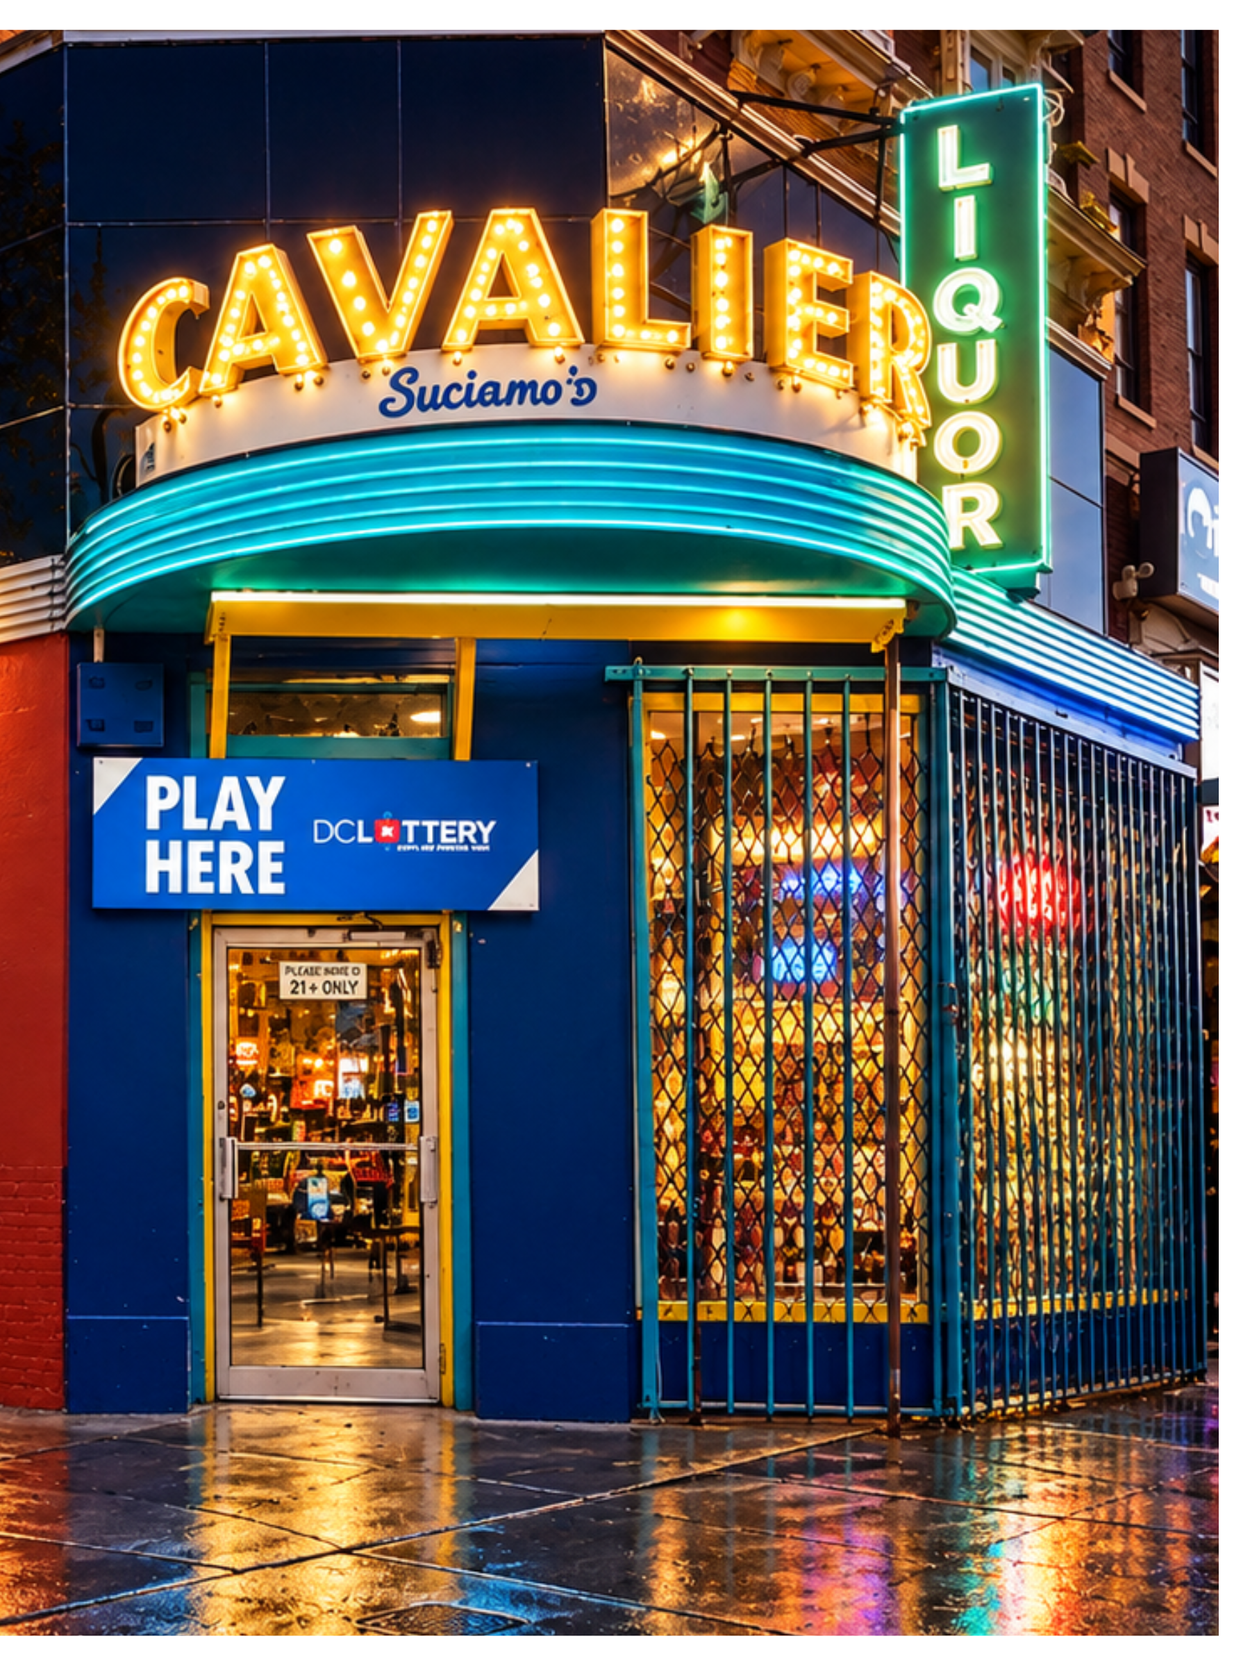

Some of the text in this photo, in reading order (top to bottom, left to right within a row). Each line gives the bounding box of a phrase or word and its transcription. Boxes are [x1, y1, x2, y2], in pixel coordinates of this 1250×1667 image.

[118, 208, 933, 432] CAVALIER
[933, 125, 1003, 549] LIQUOR
[146, 775, 286, 831] PLAY
[146, 840, 286, 894] HERE
[322, 980, 358, 995] ONLY
